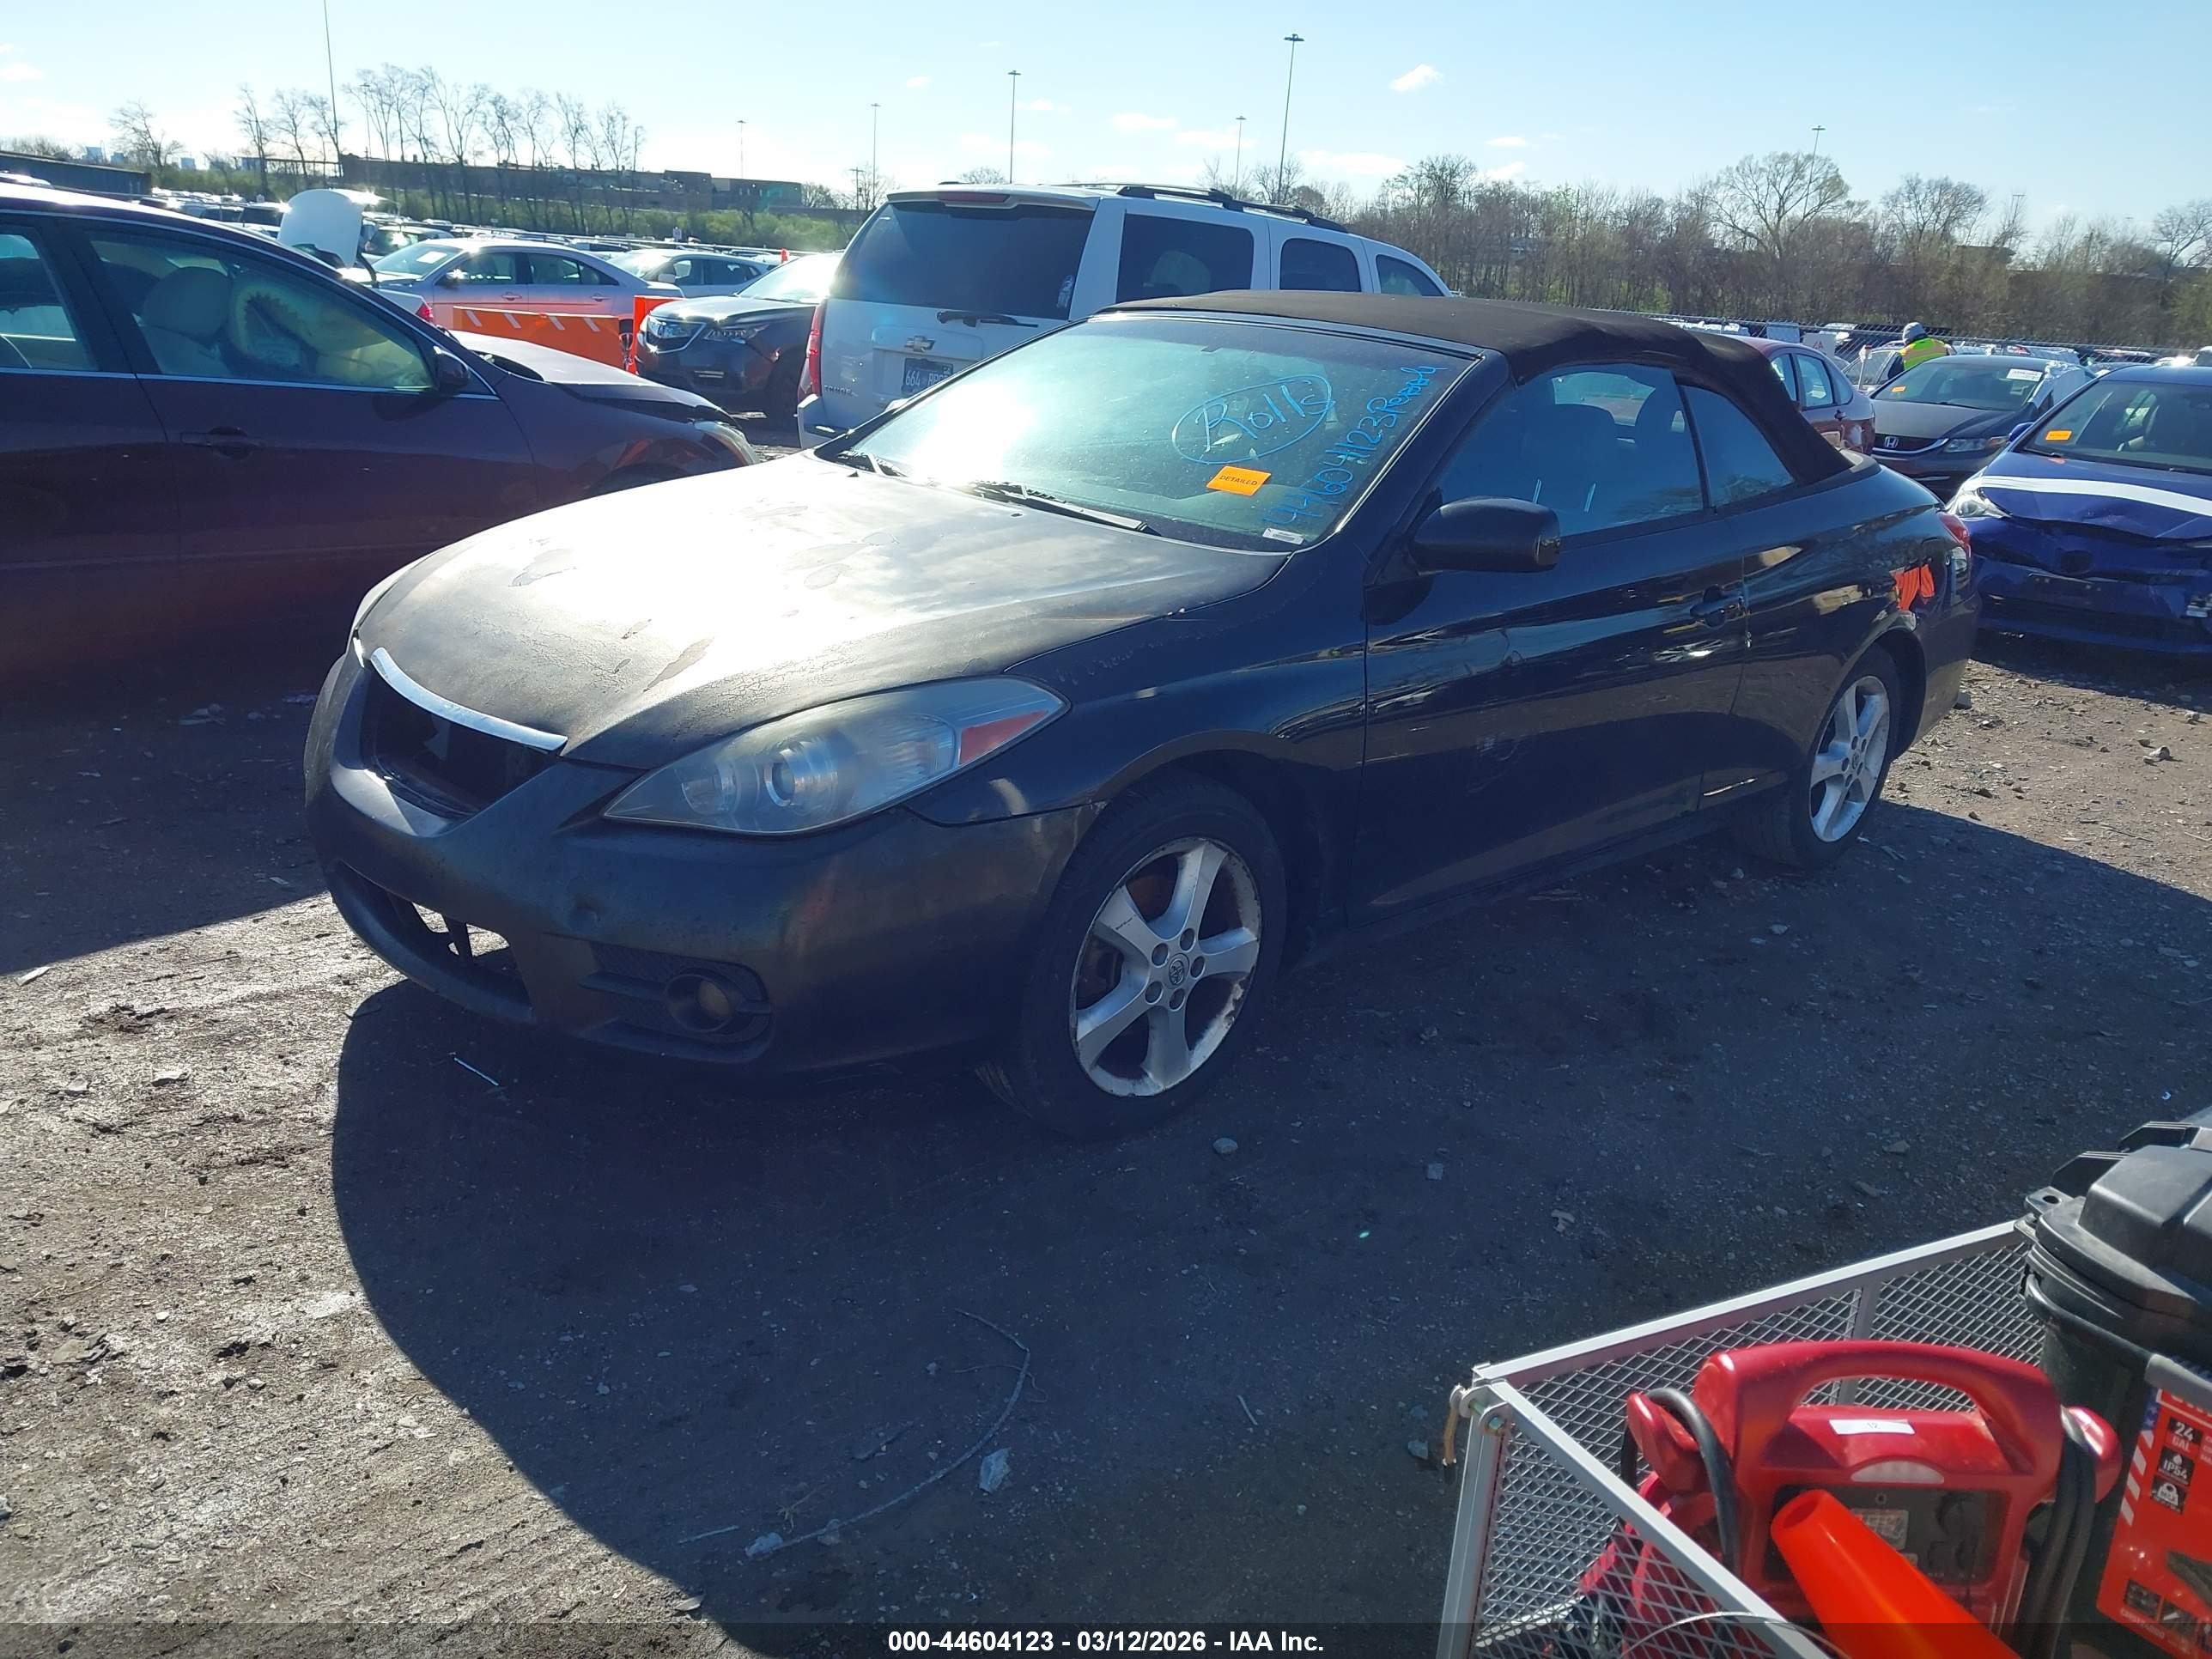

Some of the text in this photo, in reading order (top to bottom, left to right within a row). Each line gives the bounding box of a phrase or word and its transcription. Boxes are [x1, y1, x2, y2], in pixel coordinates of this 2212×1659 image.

[1218, 475, 1258, 486] DETAILED
[2173, 1421, 2195, 1442] 24
[2162, 1459, 2188, 1480] IP54
